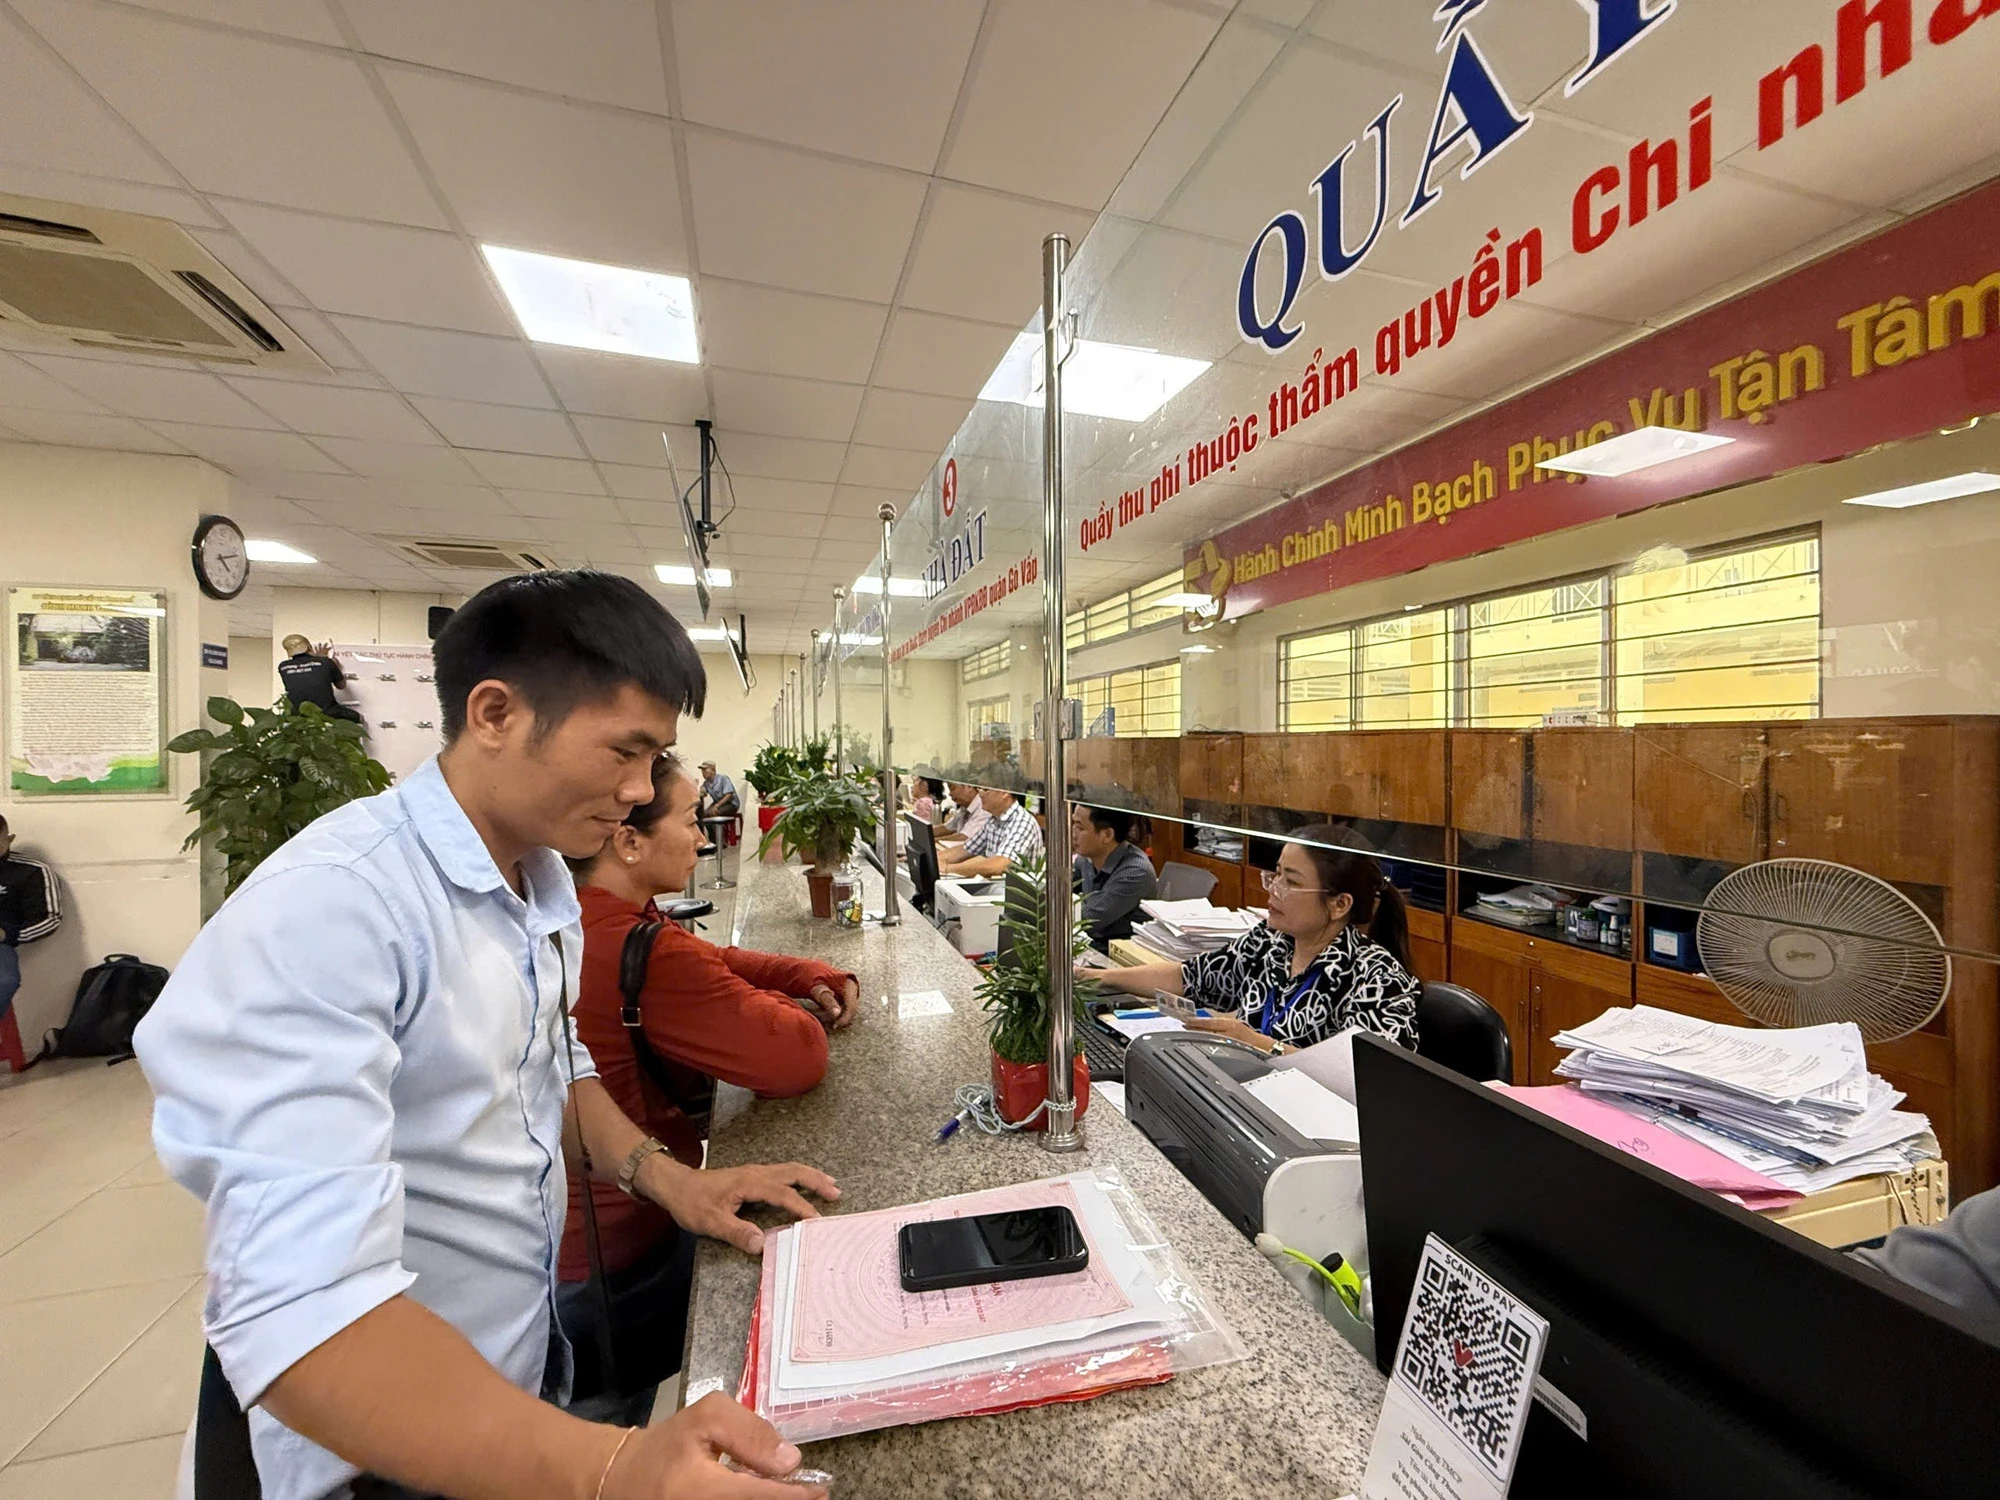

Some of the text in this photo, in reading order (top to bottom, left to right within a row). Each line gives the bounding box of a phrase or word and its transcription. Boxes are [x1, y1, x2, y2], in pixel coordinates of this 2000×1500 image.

[1080, 501, 1114, 552] Quầy
[1118, 486, 1145, 528] thu
[1150, 454, 1181, 513] phí
[1187, 413, 1259, 486] thuộc
[1268, 347, 1359, 438] thẩm
[1376, 227, 1543, 376] quyền
[1572, 94, 1712, 254] Chi
[1233, 542, 1280, 586] Hành
[1281, 517, 1341, 568] Chính
[1344, 494, 1405, 547] Minh
[1412, 459, 1496, 526] Bạch
[1708, 347, 1826, 426] Tận
[1836, 270, 2000, 378] Tâm
[951, 508, 987, 585] ĐẤT
[1008, 563, 1019, 594] Gò
[1020, 546, 1038, 587] Vấp
[1444, 1253, 1516, 1313] SCAN TO PAY
